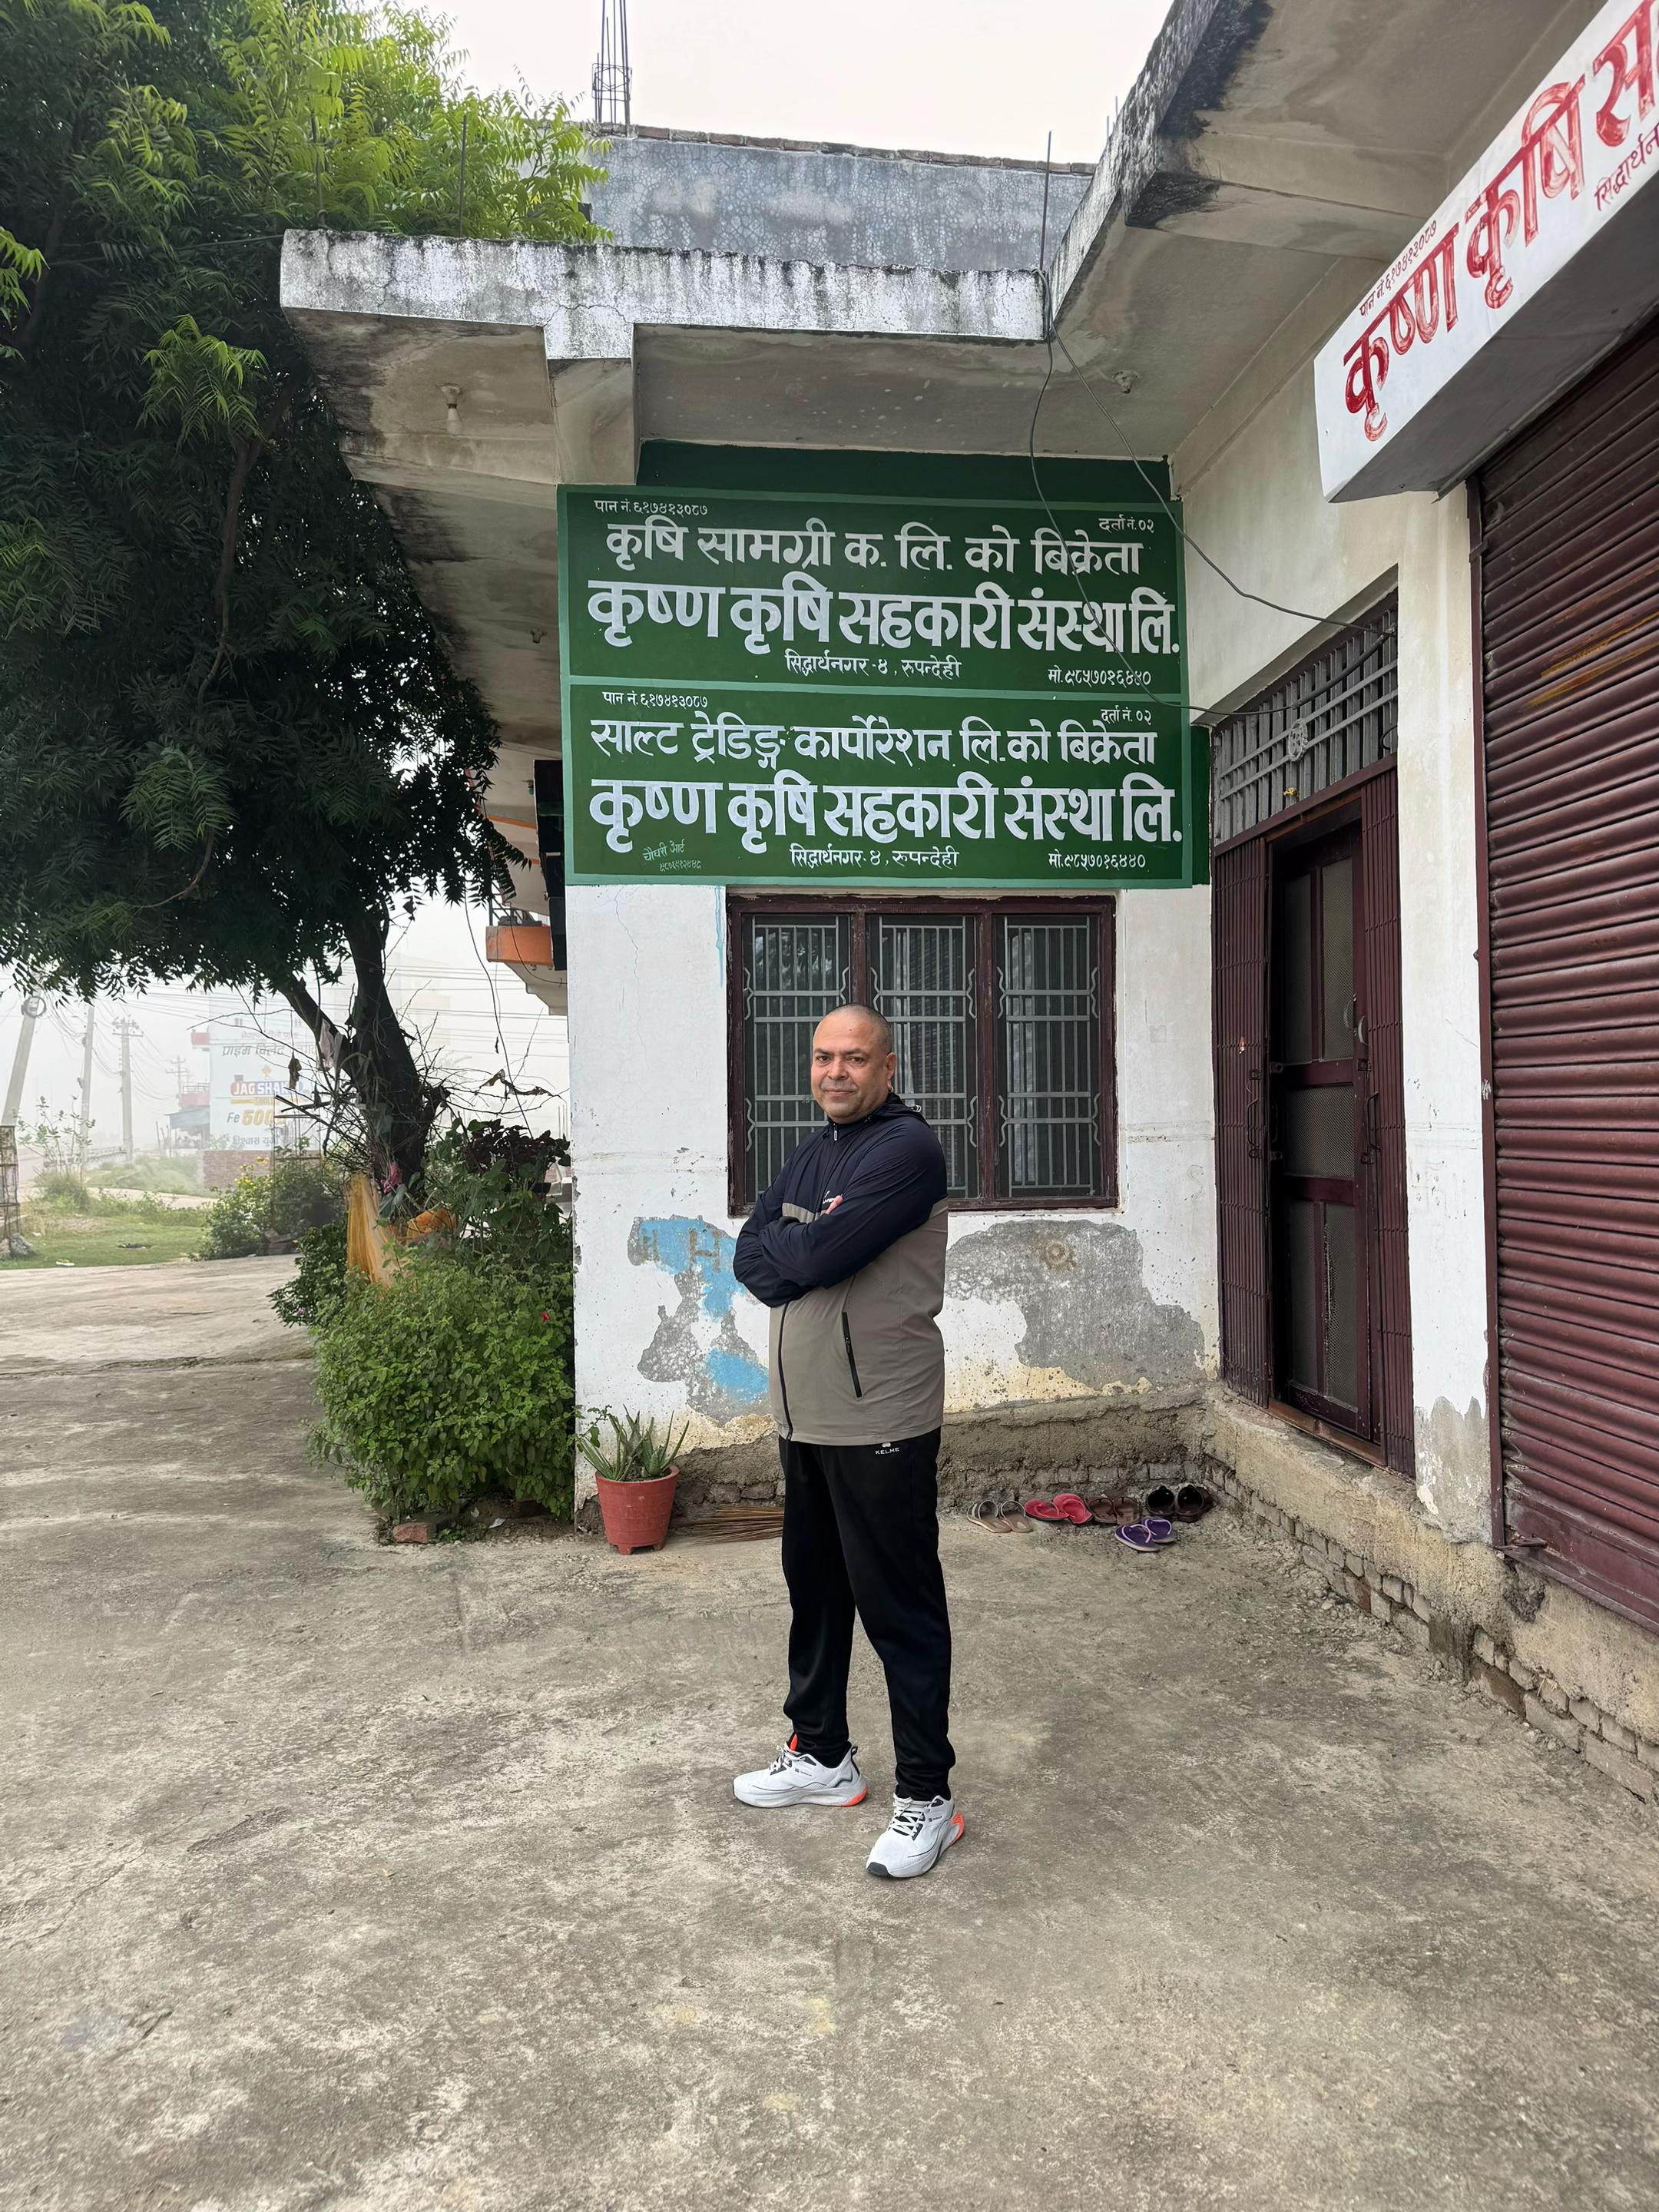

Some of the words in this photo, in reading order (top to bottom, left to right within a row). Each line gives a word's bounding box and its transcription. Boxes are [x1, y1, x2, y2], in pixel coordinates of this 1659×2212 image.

[1343, 221, 1459, 442] कृष्ण
[1464, 74, 1585, 309] कृषि
[1592, 0, 1659, 147] स
[594, 499, 618, 513] पान
[1098, 514, 1125, 532] दर्ता
[606, 515, 689, 571] कृषि
[697, 517, 836, 569] सामग्री
[844, 532, 887, 568] क.
[894, 522, 953, 571] लि.
[965, 524, 1021, 575] को
[1030, 527, 1144, 576] बिक्रेता
[587, 579, 727, 647] कृष्ण
[730, 571, 833, 655] कृषि
[839, 581, 1015, 650] सहकारी
[1017, 587, 1127, 654] संस्था
[1128, 586, 1181, 654] लि.
[602, 691, 624, 706] पान
[1100, 704, 1120, 725] दर्ता
[591, 719, 684, 757] साल्ट
[1057, 718, 1158, 765] बिक्रेता
[589, 779, 723, 853] कृष्ण
[727, 769, 818, 853] कृषि
[823, 770, 998, 843] सहकारी
[1003, 775, 1116, 842] संस्था
[1119, 772, 1183, 843] लि.
[669, 839, 685, 853] आर्ट
[233, 1083, 255, 1095] JAG
[227, 1113, 240, 1123] Fe
